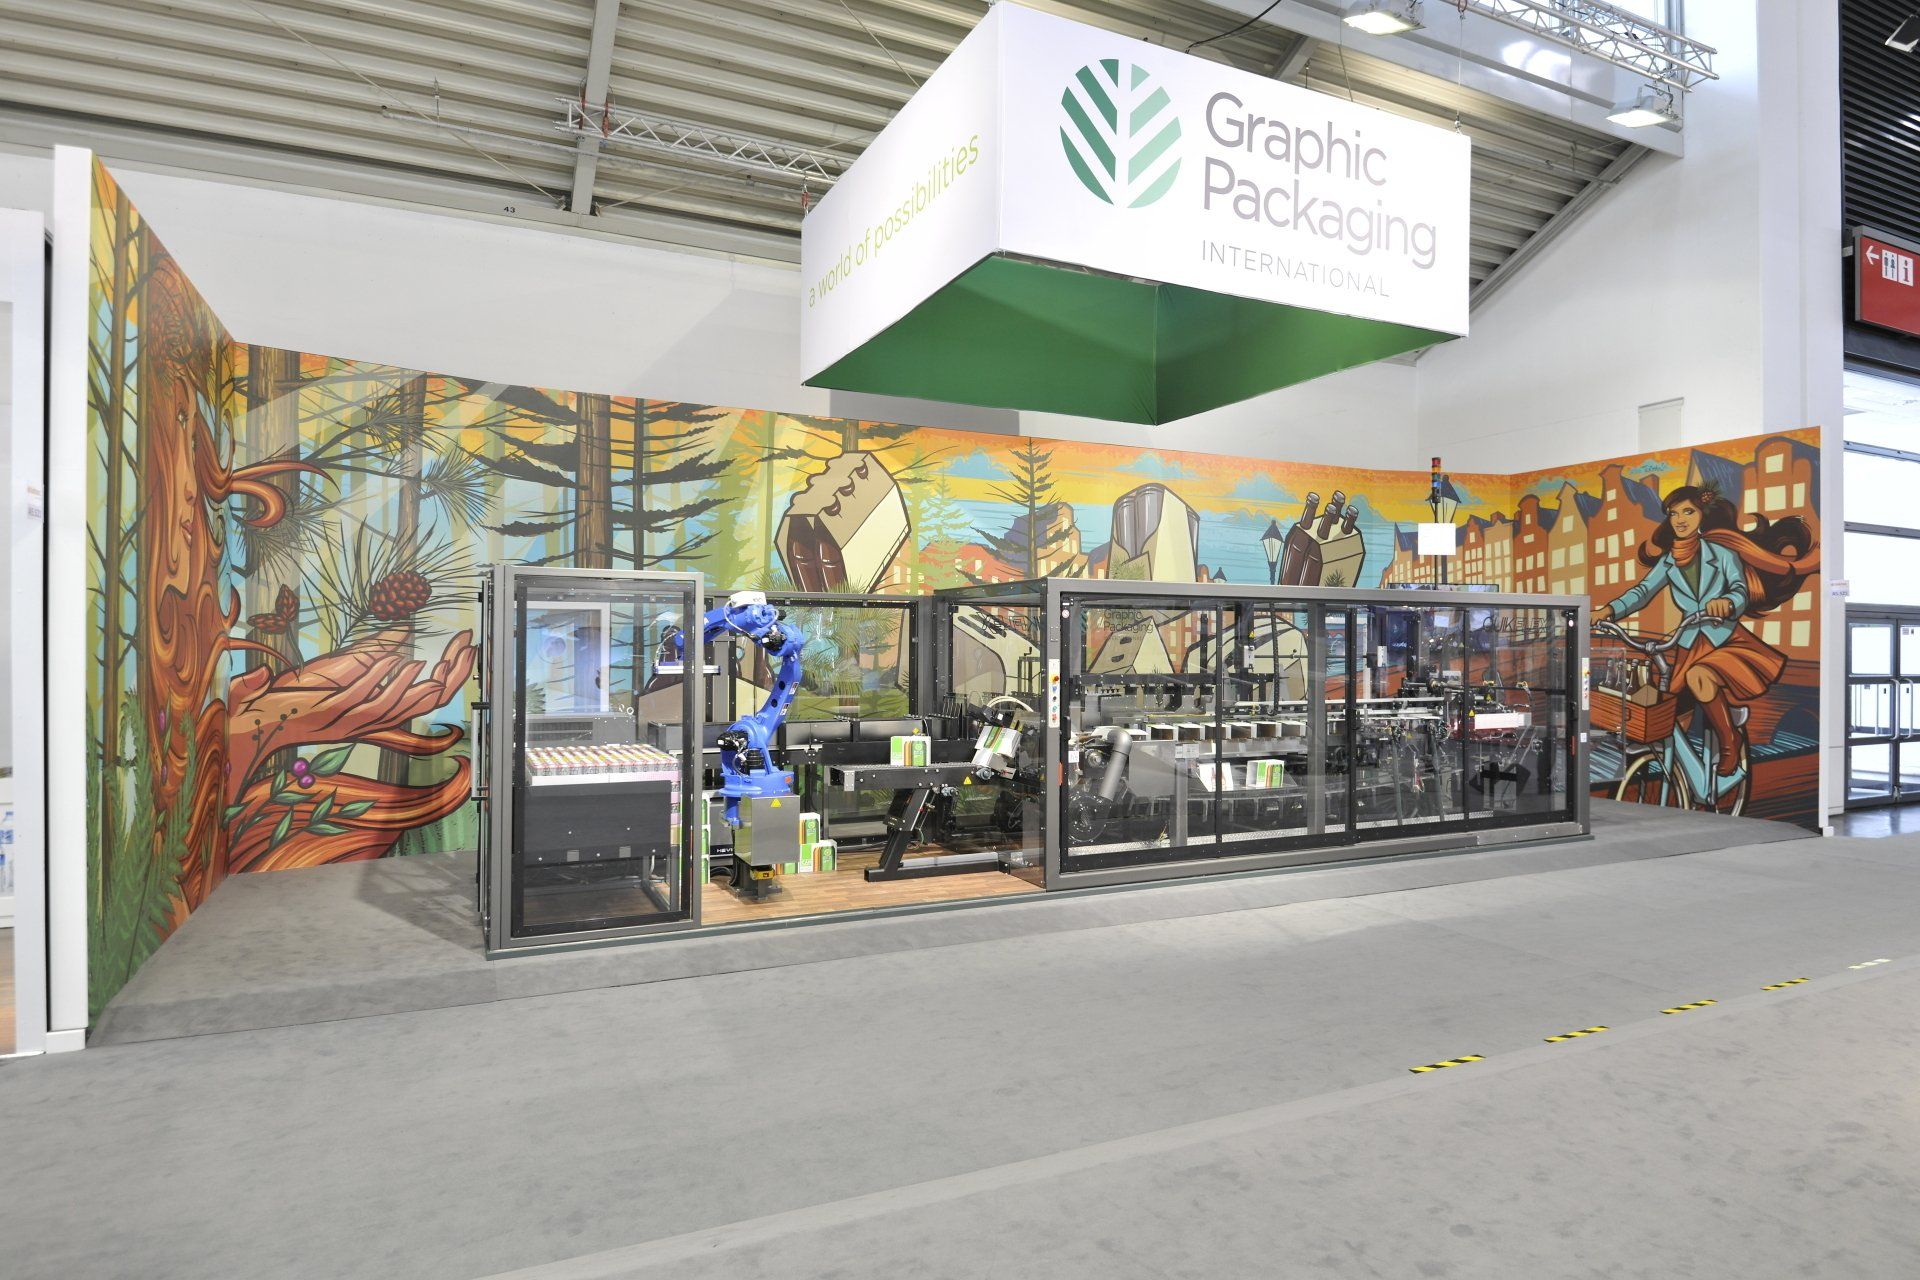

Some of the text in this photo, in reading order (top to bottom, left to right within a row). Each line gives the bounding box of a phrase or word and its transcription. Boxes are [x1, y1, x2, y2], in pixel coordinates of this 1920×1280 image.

[1205, 91, 1387, 187] Graphic
[808, 134, 980, 308] a world of possibilities
[1203, 156, 1437, 270] Packaging
[1202, 239, 1390, 298] INTERNATIONAL
[1103, 608, 1143, 622] Graphic
[1103, 619, 1154, 634] Packaging
